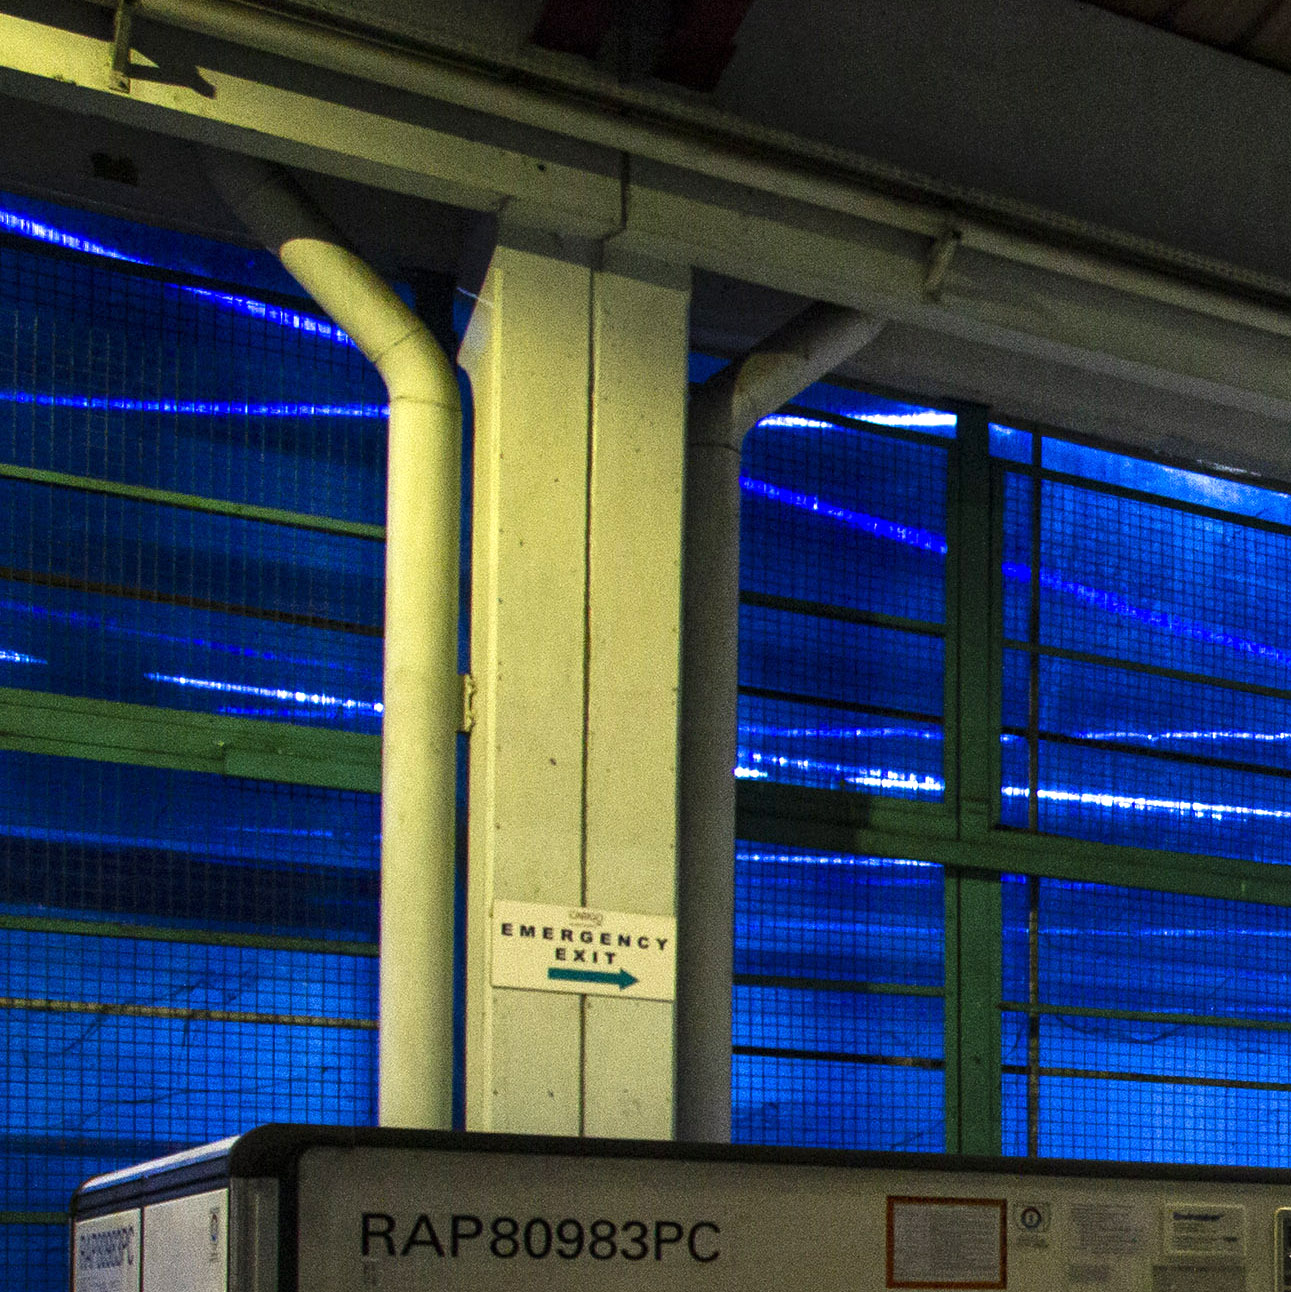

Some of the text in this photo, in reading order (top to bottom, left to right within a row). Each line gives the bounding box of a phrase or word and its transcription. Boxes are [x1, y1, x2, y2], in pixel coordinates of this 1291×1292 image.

[501, 922, 668, 950] EMERGENCY
[555, 947, 617, 965] EXIT
[361, 1211, 721, 1263] RAP80983PC
